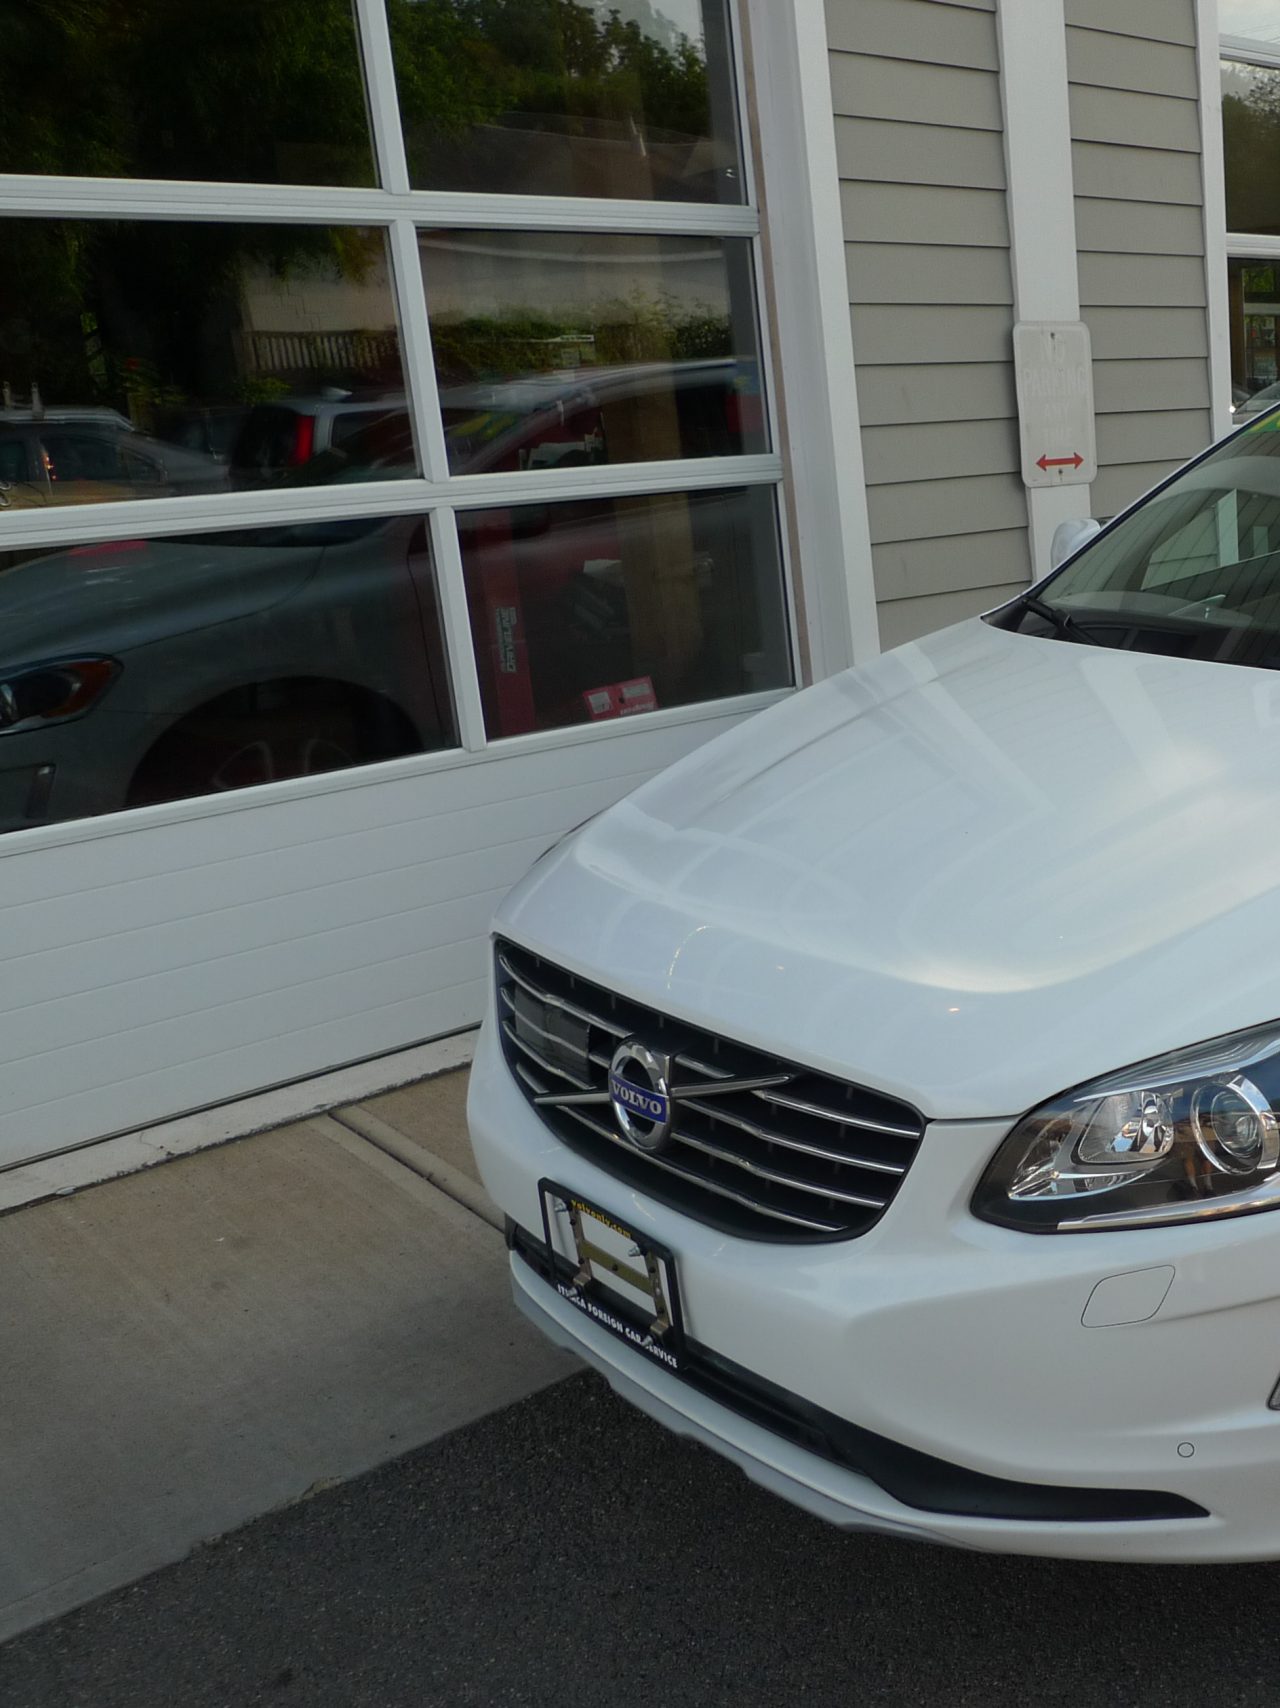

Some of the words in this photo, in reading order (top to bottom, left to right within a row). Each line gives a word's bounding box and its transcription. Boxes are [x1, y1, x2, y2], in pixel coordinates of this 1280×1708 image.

[612, 1081, 662, 1115] VOLVO
[587, 1303, 624, 1333] FOREIGN
[644, 1342, 677, 1368] ERVICE
